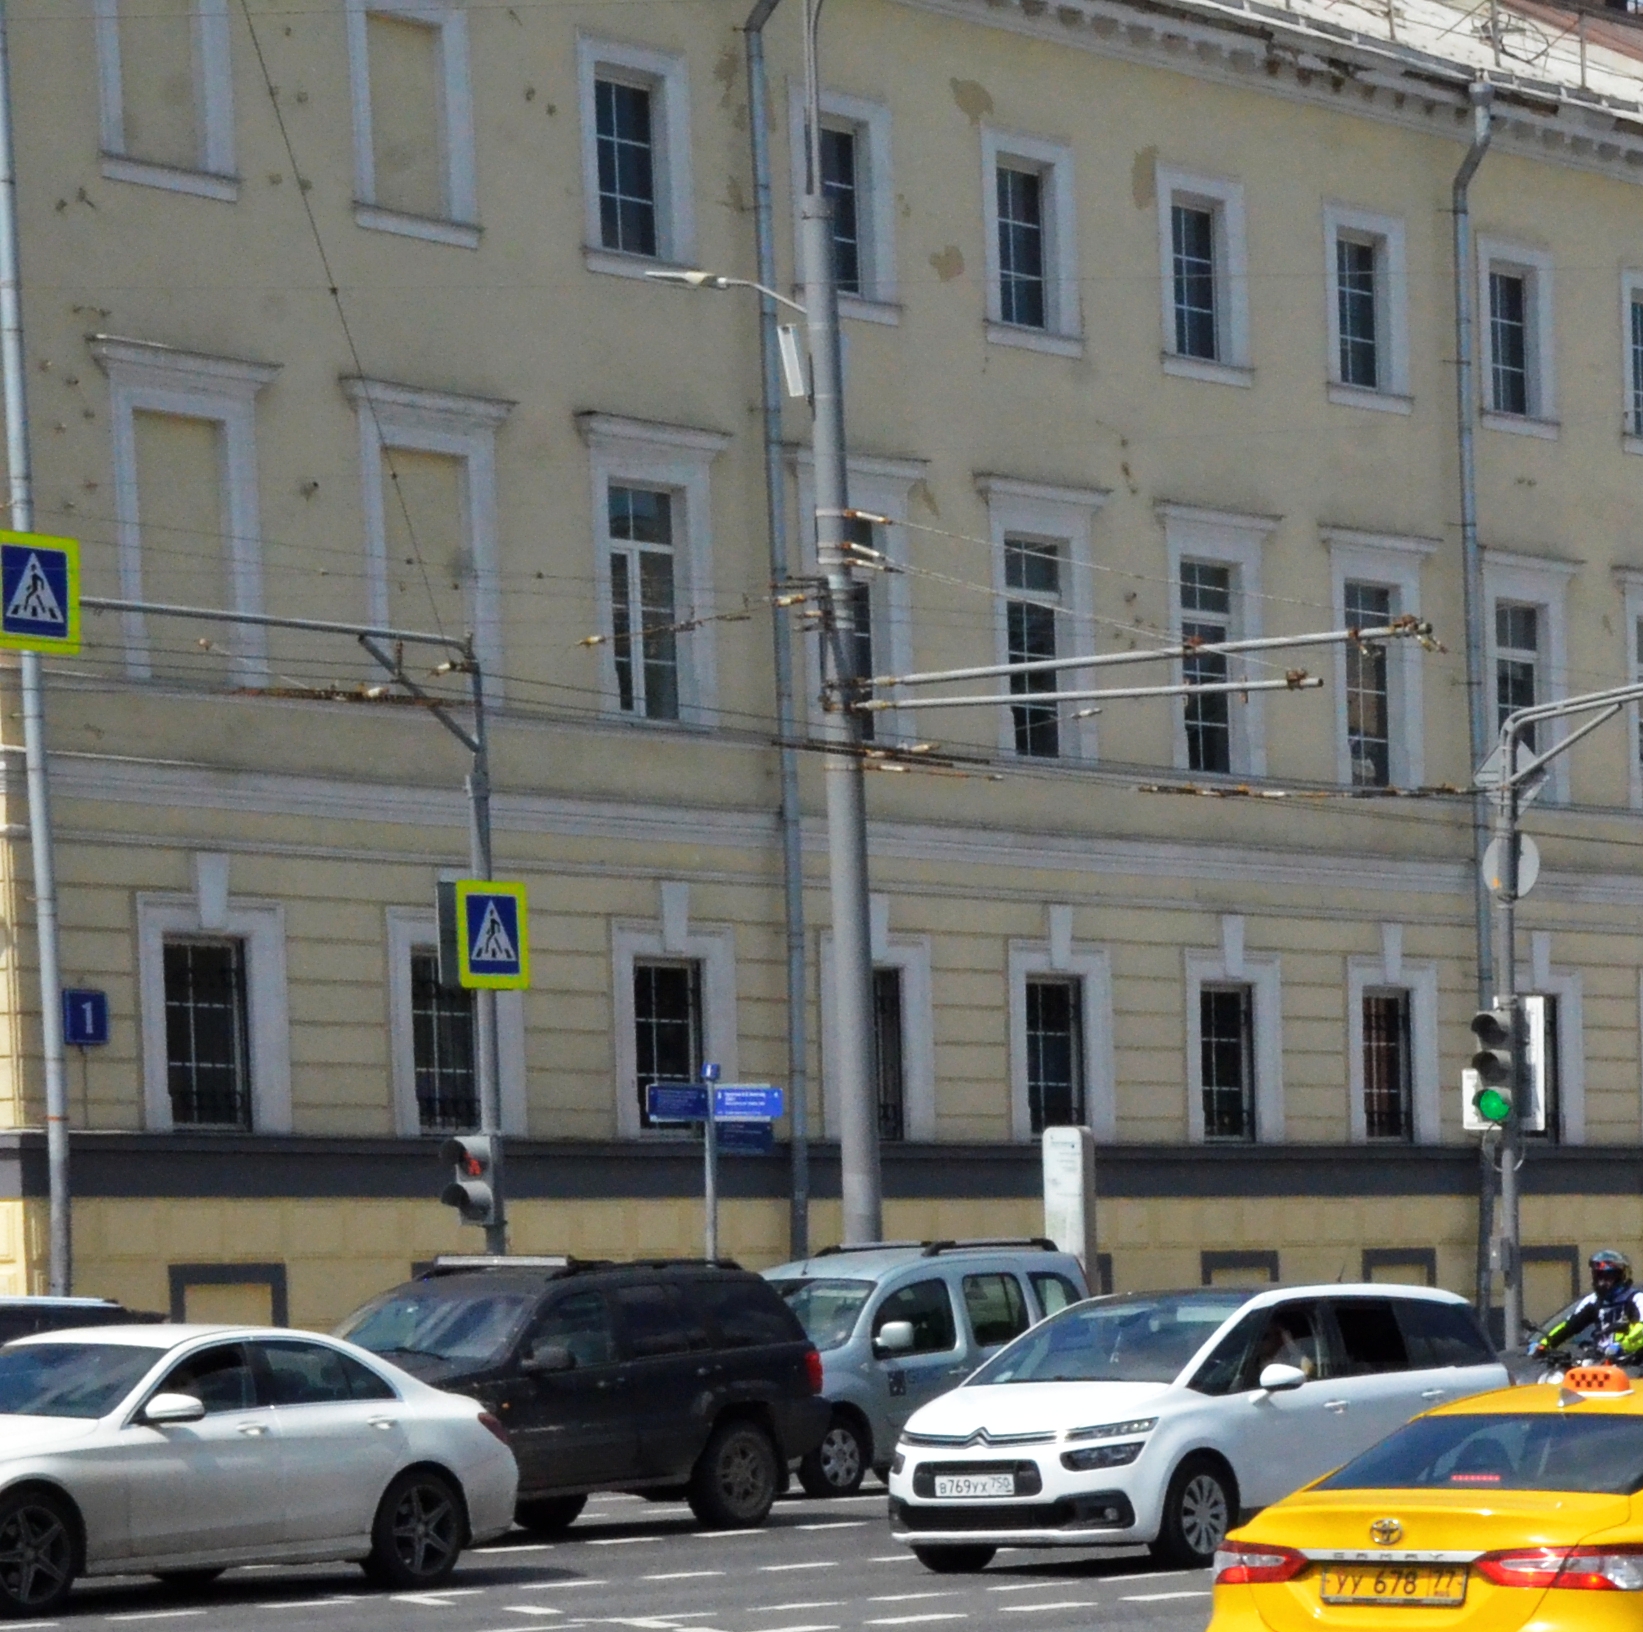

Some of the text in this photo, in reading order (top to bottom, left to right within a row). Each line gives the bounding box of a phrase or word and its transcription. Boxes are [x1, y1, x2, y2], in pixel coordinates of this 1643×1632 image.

[81, 1001, 94, 1034] 1
[939, 1477, 1010, 1495] В769УХ 750
[1337, 1569, 1457, 1595] УУ 678 77
